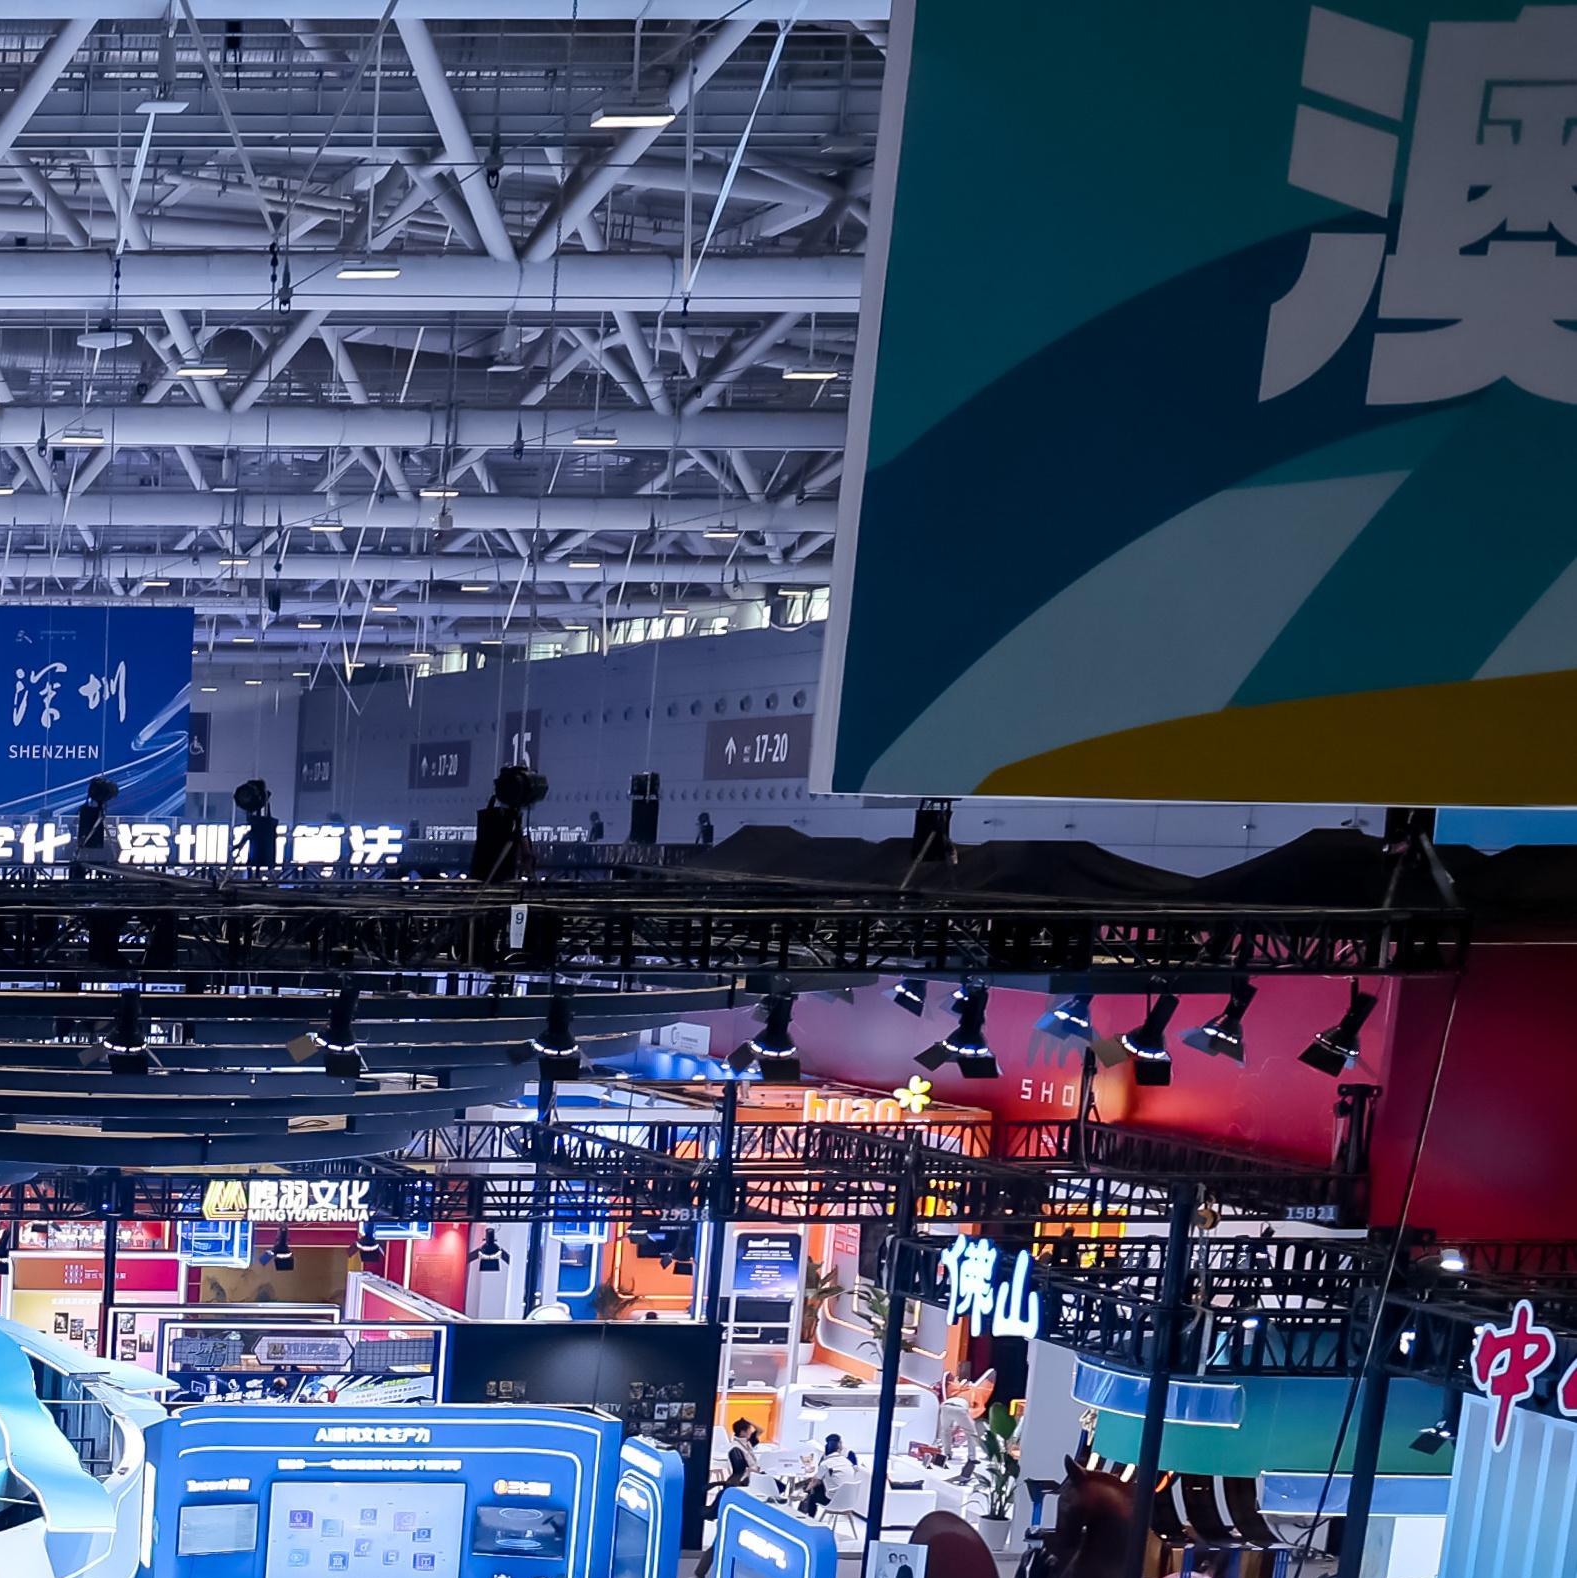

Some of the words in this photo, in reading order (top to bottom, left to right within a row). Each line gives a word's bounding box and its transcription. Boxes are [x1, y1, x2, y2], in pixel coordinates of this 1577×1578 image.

[1258, 3, 1577, 405] 澳
[12, 660, 128, 729] 深圳
[8, 744, 100, 760] SHENZHEN
[755, 733, 788, 764] 17-20
[515, 912, 524, 925] 9
[803, 1090, 900, 1122] huan
[247, 1181, 370, 1210] 鸣羽文化
[247, 1209, 370, 1221] MINGYUWENHUA
[1285, 1207, 1335, 1220] 15B21
